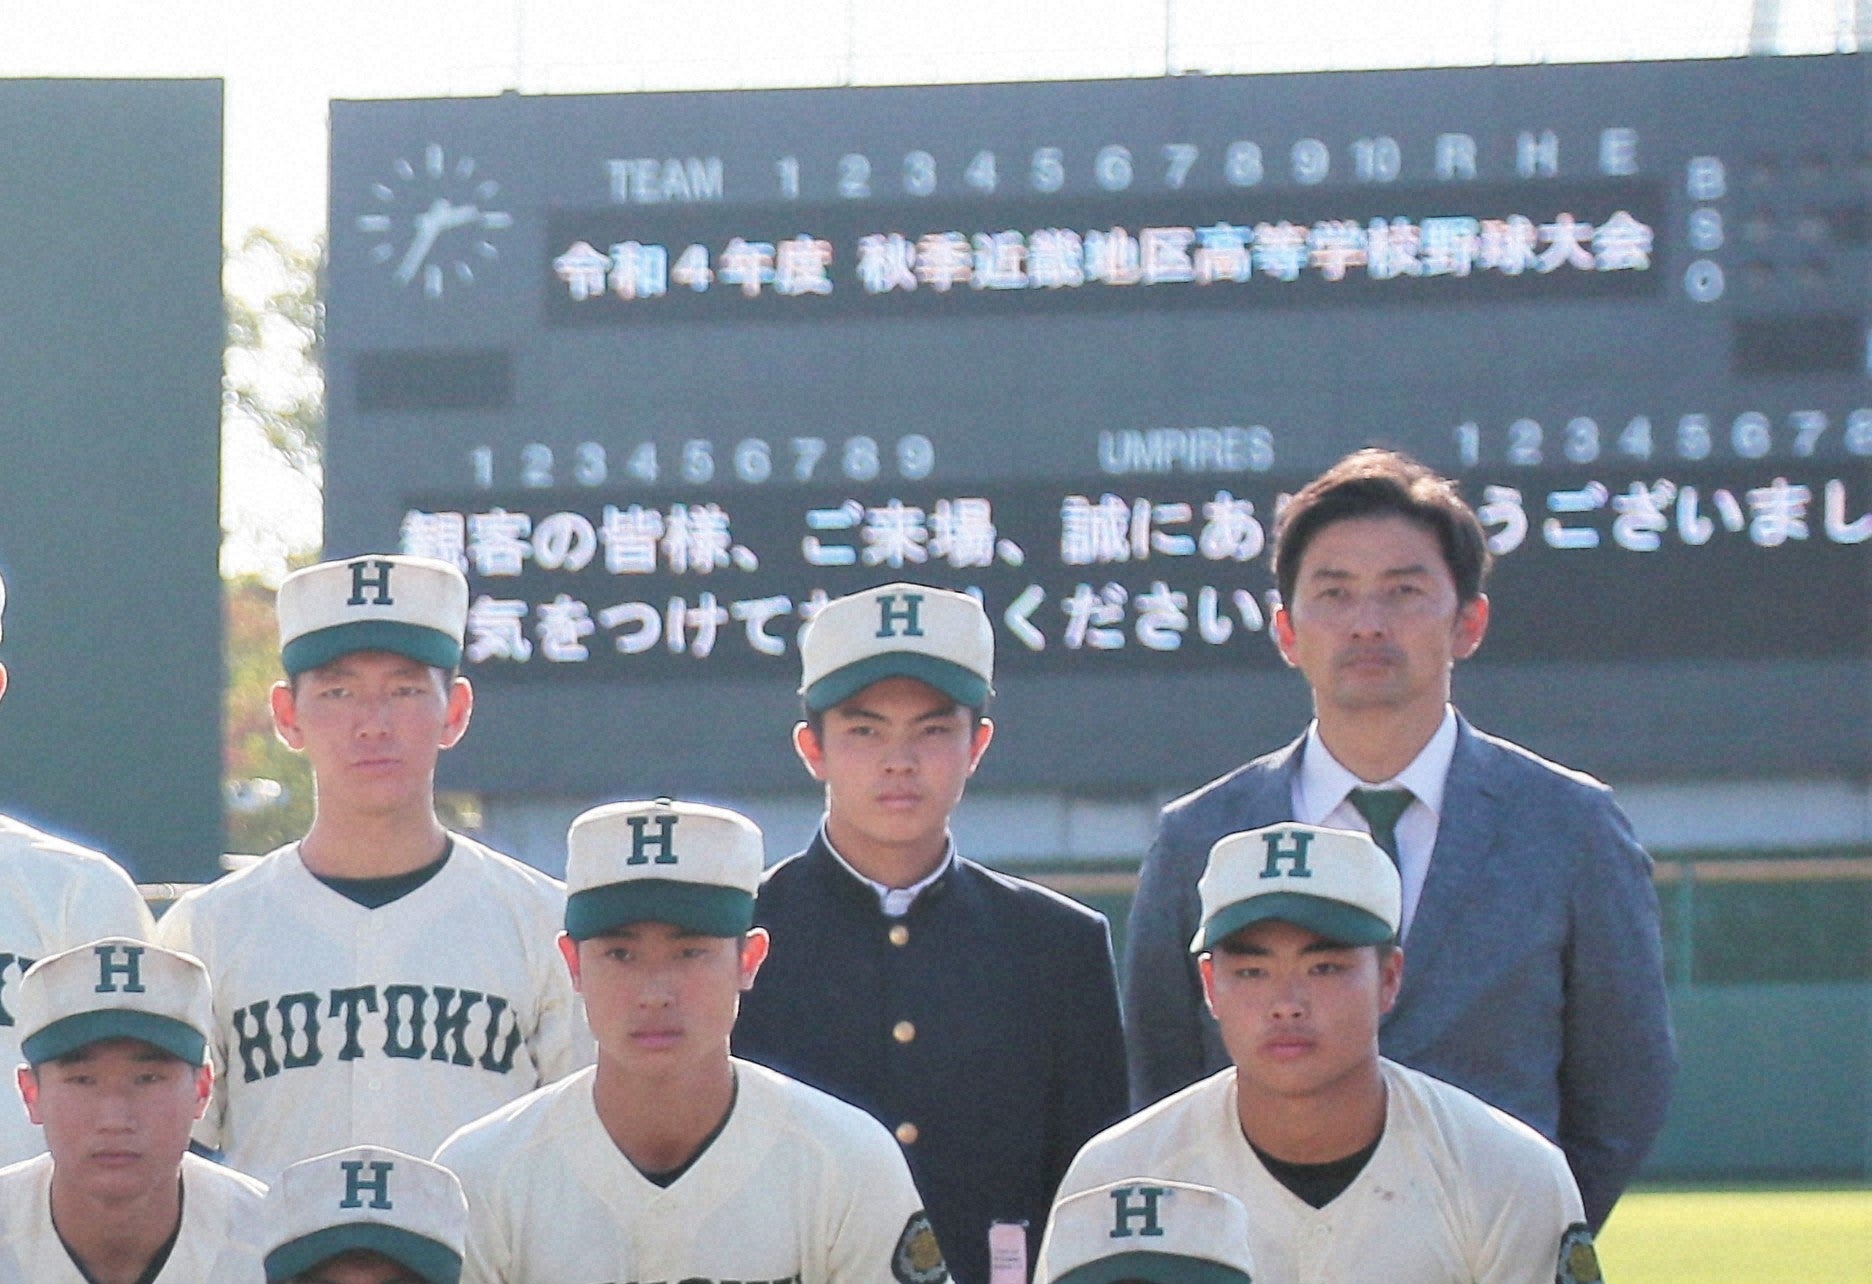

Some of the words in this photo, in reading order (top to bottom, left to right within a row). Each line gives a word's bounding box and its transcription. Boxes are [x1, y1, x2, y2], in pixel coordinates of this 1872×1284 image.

[606, 157, 724, 203] TEAM
[776, 156, 800, 198] 1
[838, 153, 871, 199] 2
[903, 150, 937, 197] 3
[964, 149, 997, 194] 4
[1031, 146, 1064, 192] 5
[1095, 144, 1134, 191] 6
[1164, 143, 1198, 189] 7
[1226, 140, 1264, 186] 8
[1291, 139, 1329, 184] 9
[1353, 135, 1402, 183] 10
[1435, 133, 1477, 180] R
[1516, 130, 1557, 179] H
[1600, 127, 1638, 175] E
[1687, 156, 1726, 200] B
[1689, 207, 1724, 250] S
[1685, 259, 1724, 302] O
[471, 446, 494, 486] 1
[521, 443, 555, 488] 2
[575, 441, 608, 487] 3
[626, 440, 658, 482] 4
[681, 438, 716, 484] 5
[734, 438, 772, 484] 6
[790, 437, 827, 481] 7
[843, 435, 880, 481] 8
[896, 434, 936, 480] 9
[1099, 426, 1274, 474] UMPIRES
[1458, 421, 1480, 466] 1
[1507, 418, 1545, 465] 2
[1564, 416, 1600, 464] 3
[1618, 414, 1651, 461] 4
[1676, 412, 1712, 460] 5
[1731, 411, 1772, 459] 6
[1787, 410, 1828, 458] 7
[346, 561, 394, 606] H
[875, 595, 925, 638] H
[627, 815, 679, 865] H
[1259, 830, 1313, 879] H
[94, 946, 146, 994] H
[233, 984, 522, 1083] HOTOKU
[339, 1160, 393, 1210] H
[1109, 1187, 1164, 1238] H
